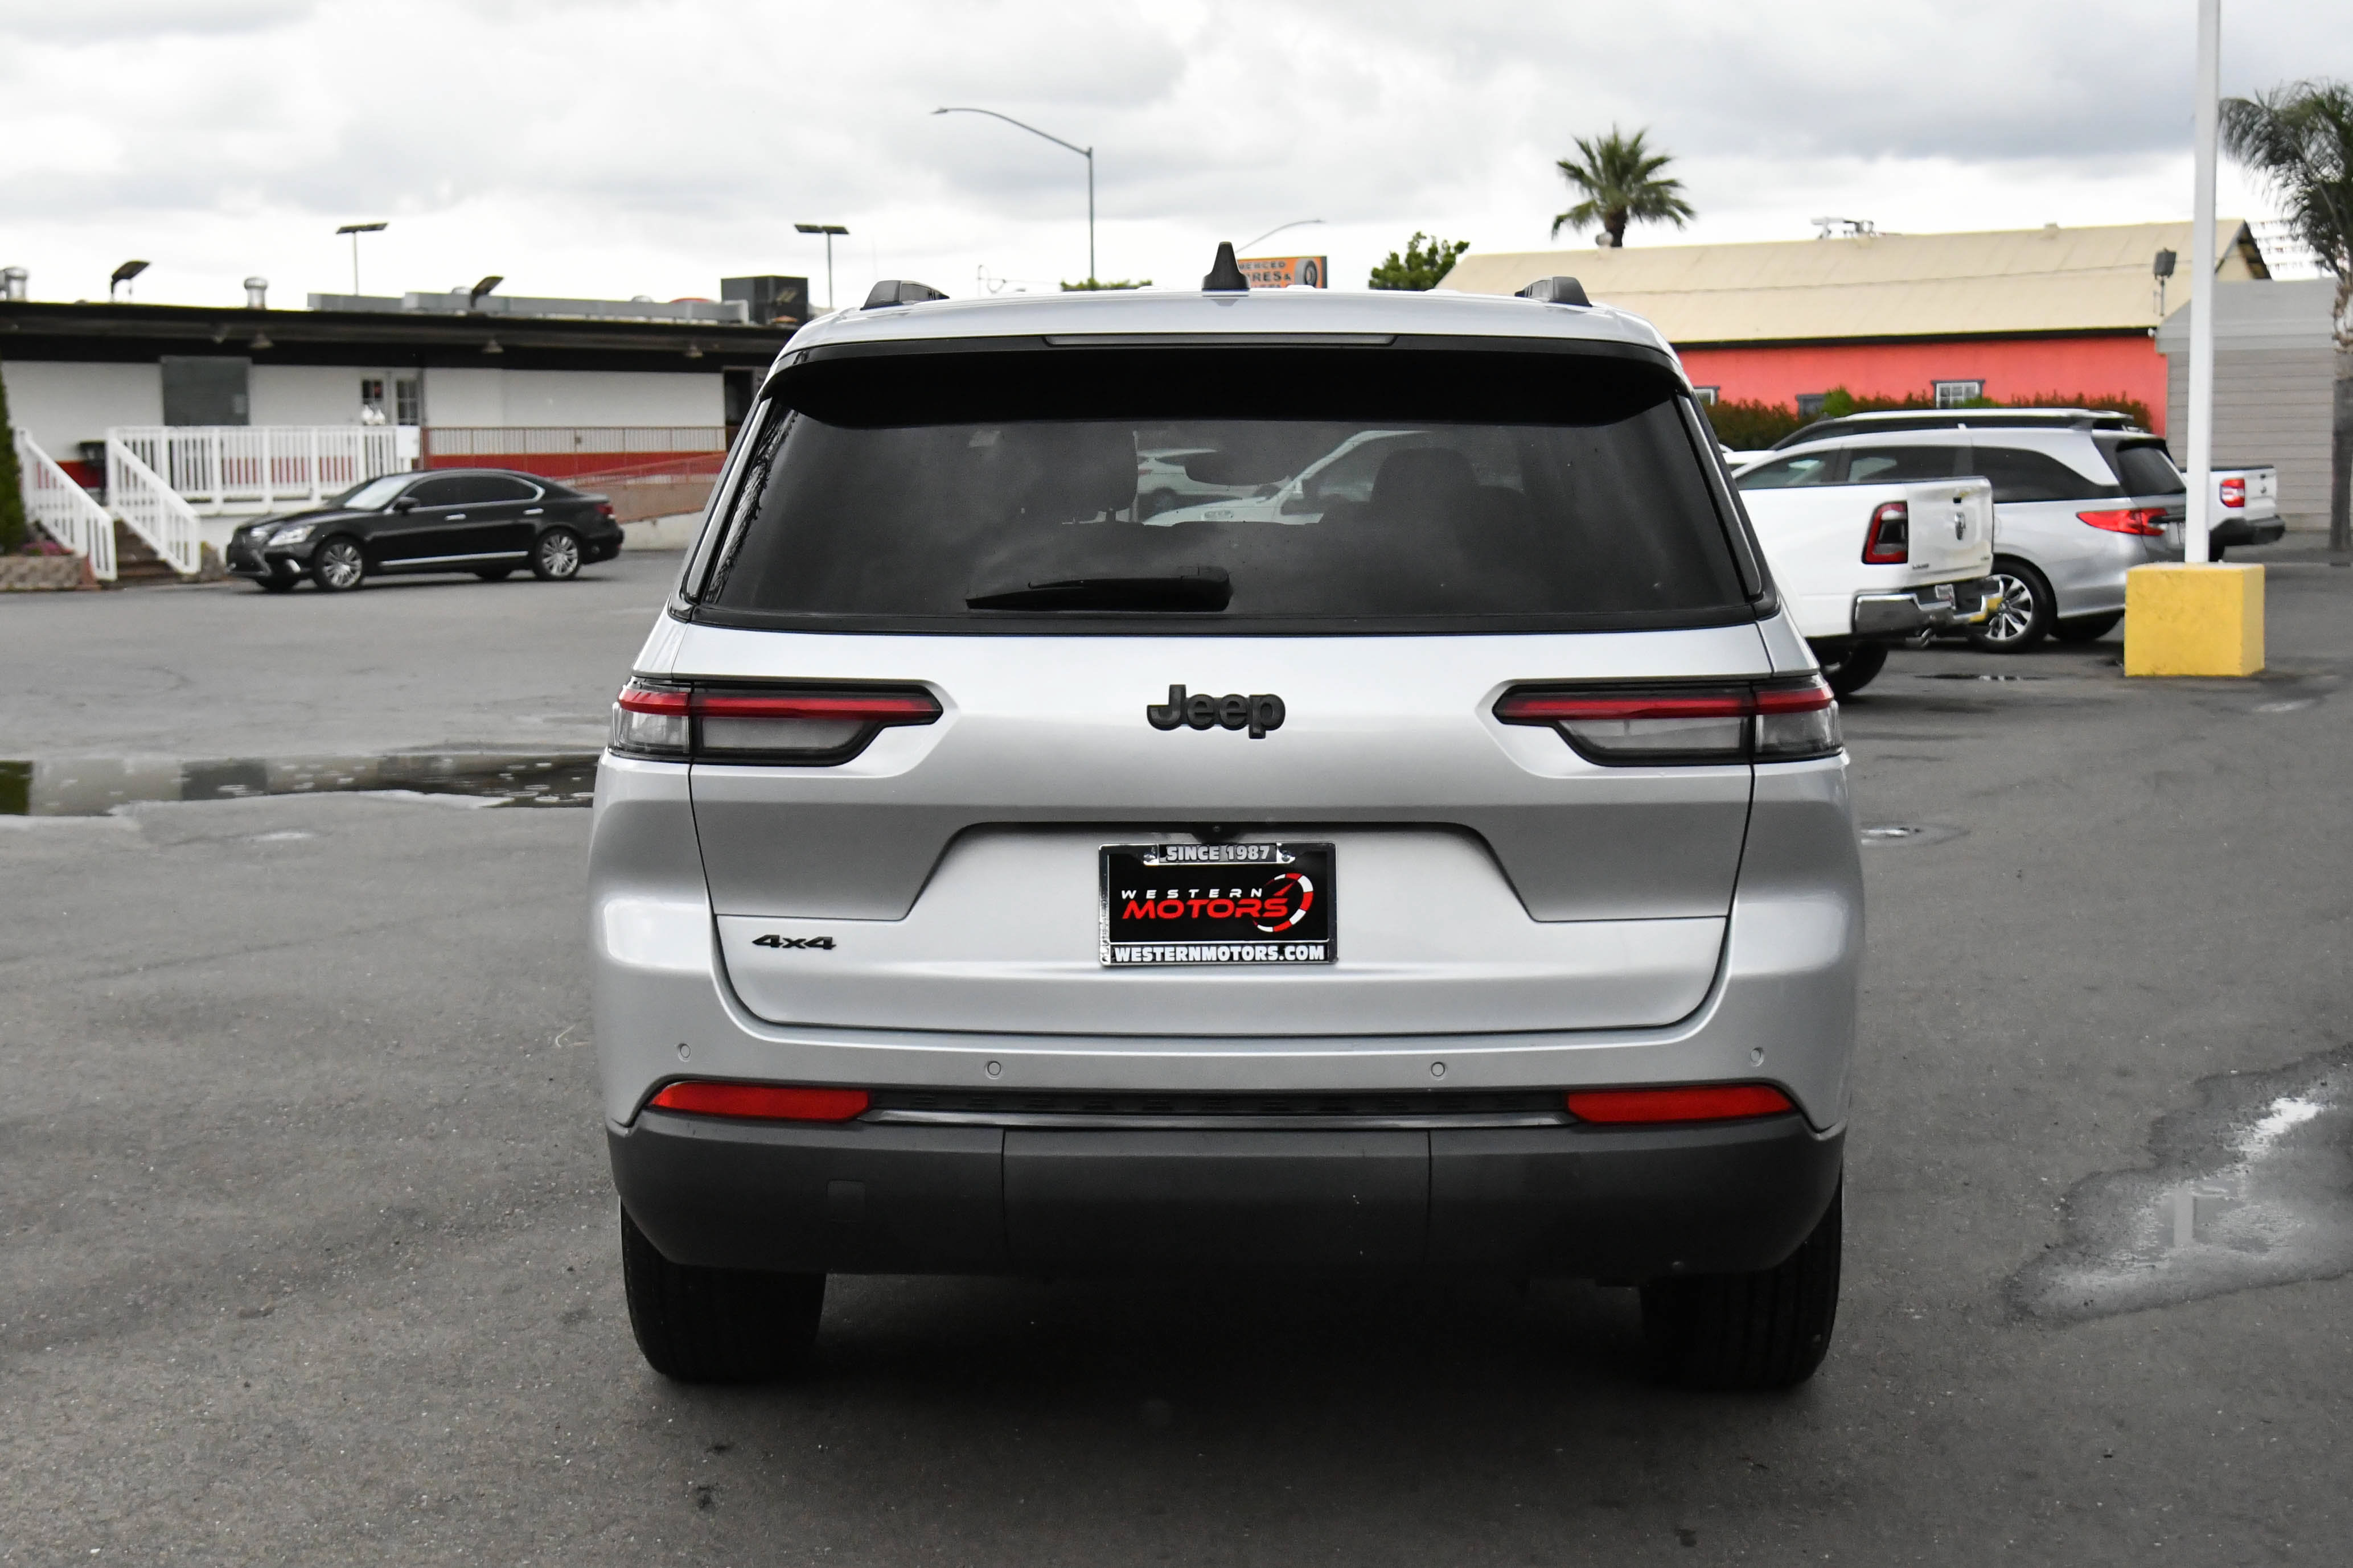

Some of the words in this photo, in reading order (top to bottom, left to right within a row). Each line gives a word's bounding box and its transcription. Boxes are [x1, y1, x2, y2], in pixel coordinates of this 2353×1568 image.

[1147, 684, 1286, 739] Jeep
[1167, 846, 1219, 861] SINCE
[1227, 846, 1270, 860] 1987
[1122, 888, 1262, 899] WESTERN
[1122, 899, 1288, 919] MOTORS
[752, 935, 836, 949] 4x4
[1115, 946, 1324, 962] WESTERNMOTORS.COM
